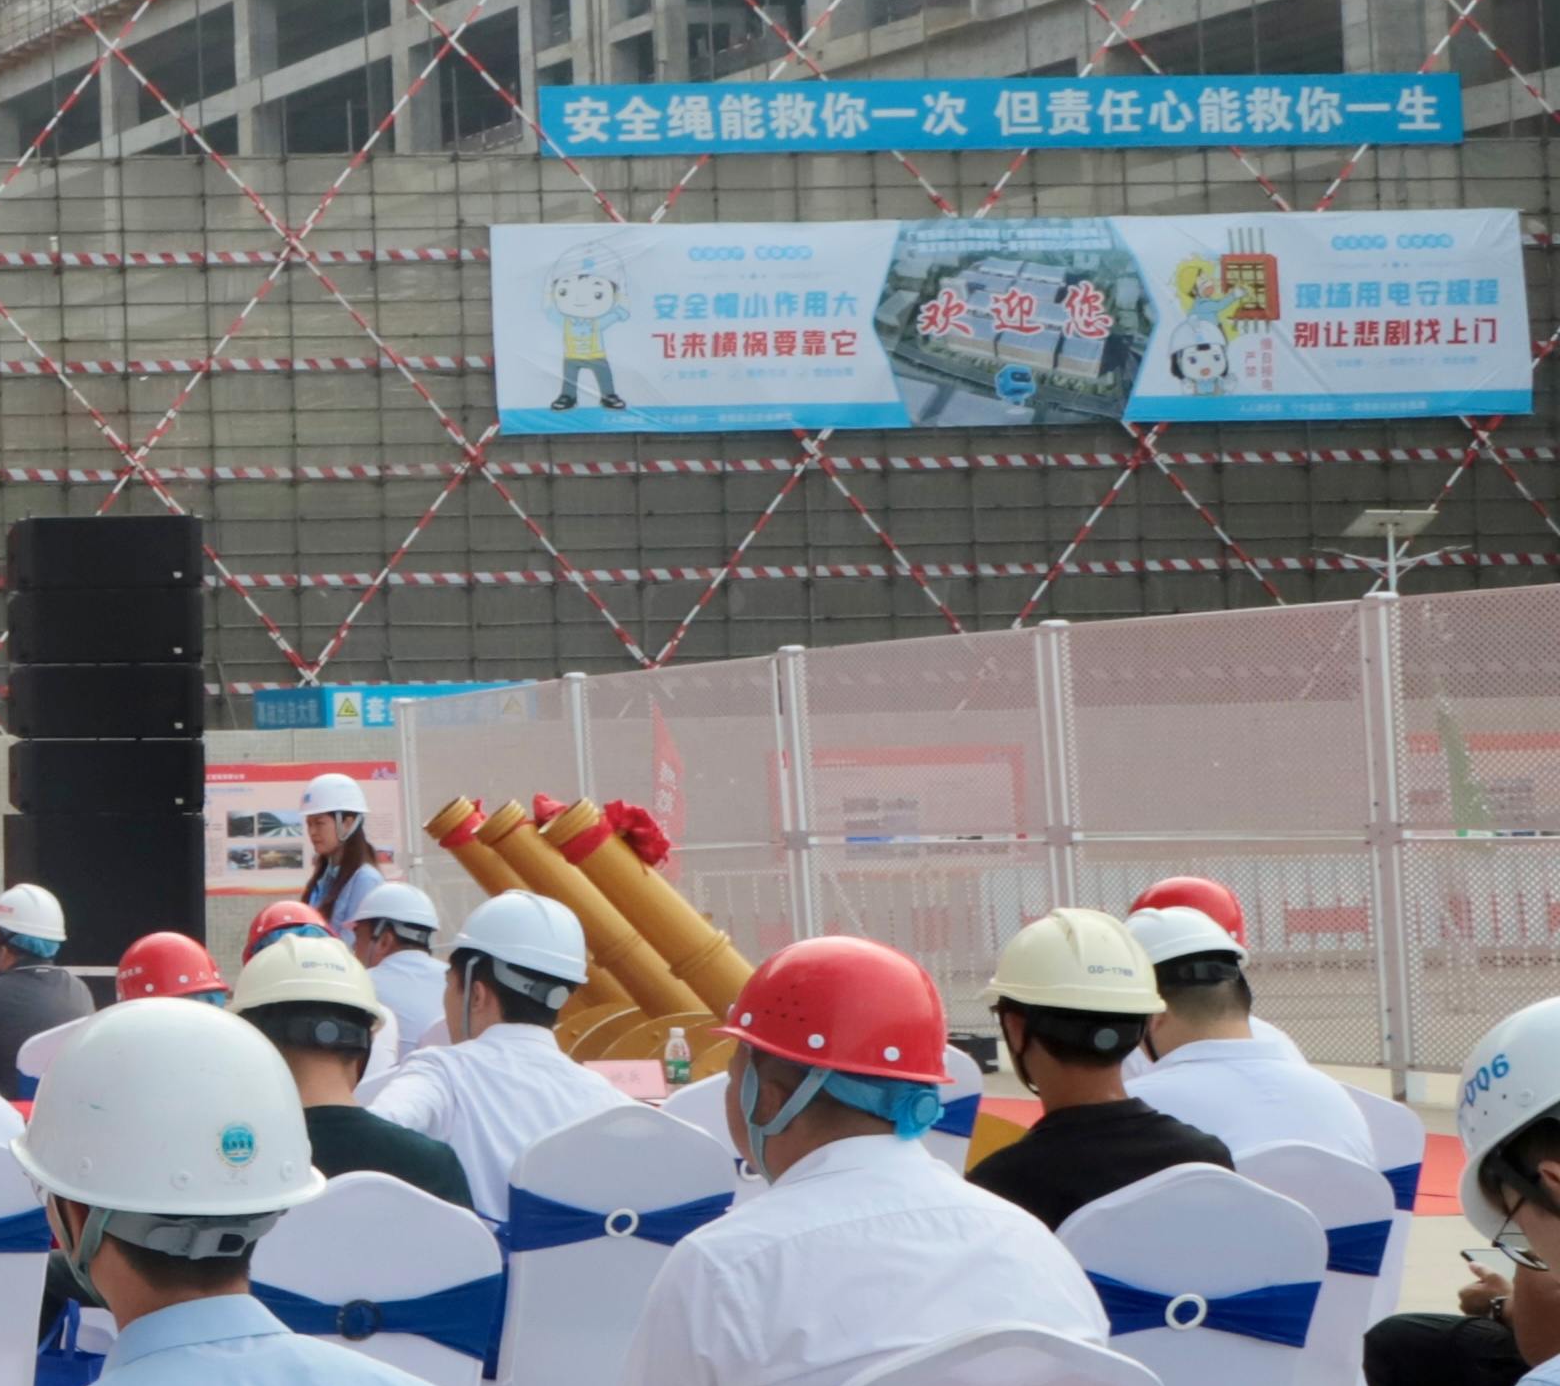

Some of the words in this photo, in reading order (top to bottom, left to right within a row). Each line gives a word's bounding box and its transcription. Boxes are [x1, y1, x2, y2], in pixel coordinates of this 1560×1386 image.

[563, 92, 968, 140] 安全绳能救你一次
[994, 84, 1442, 137] 但责任心能救你一生
[654, 291, 857, 320] 安全帽小作用大
[1295, 279, 1499, 309] 现场用电守规程
[919, 281, 1113, 339] 欢迎您
[652, 330, 857, 359] 飞来横祸要靠它
[1294, 318, 1497, 348] 别让悲剧找上门
